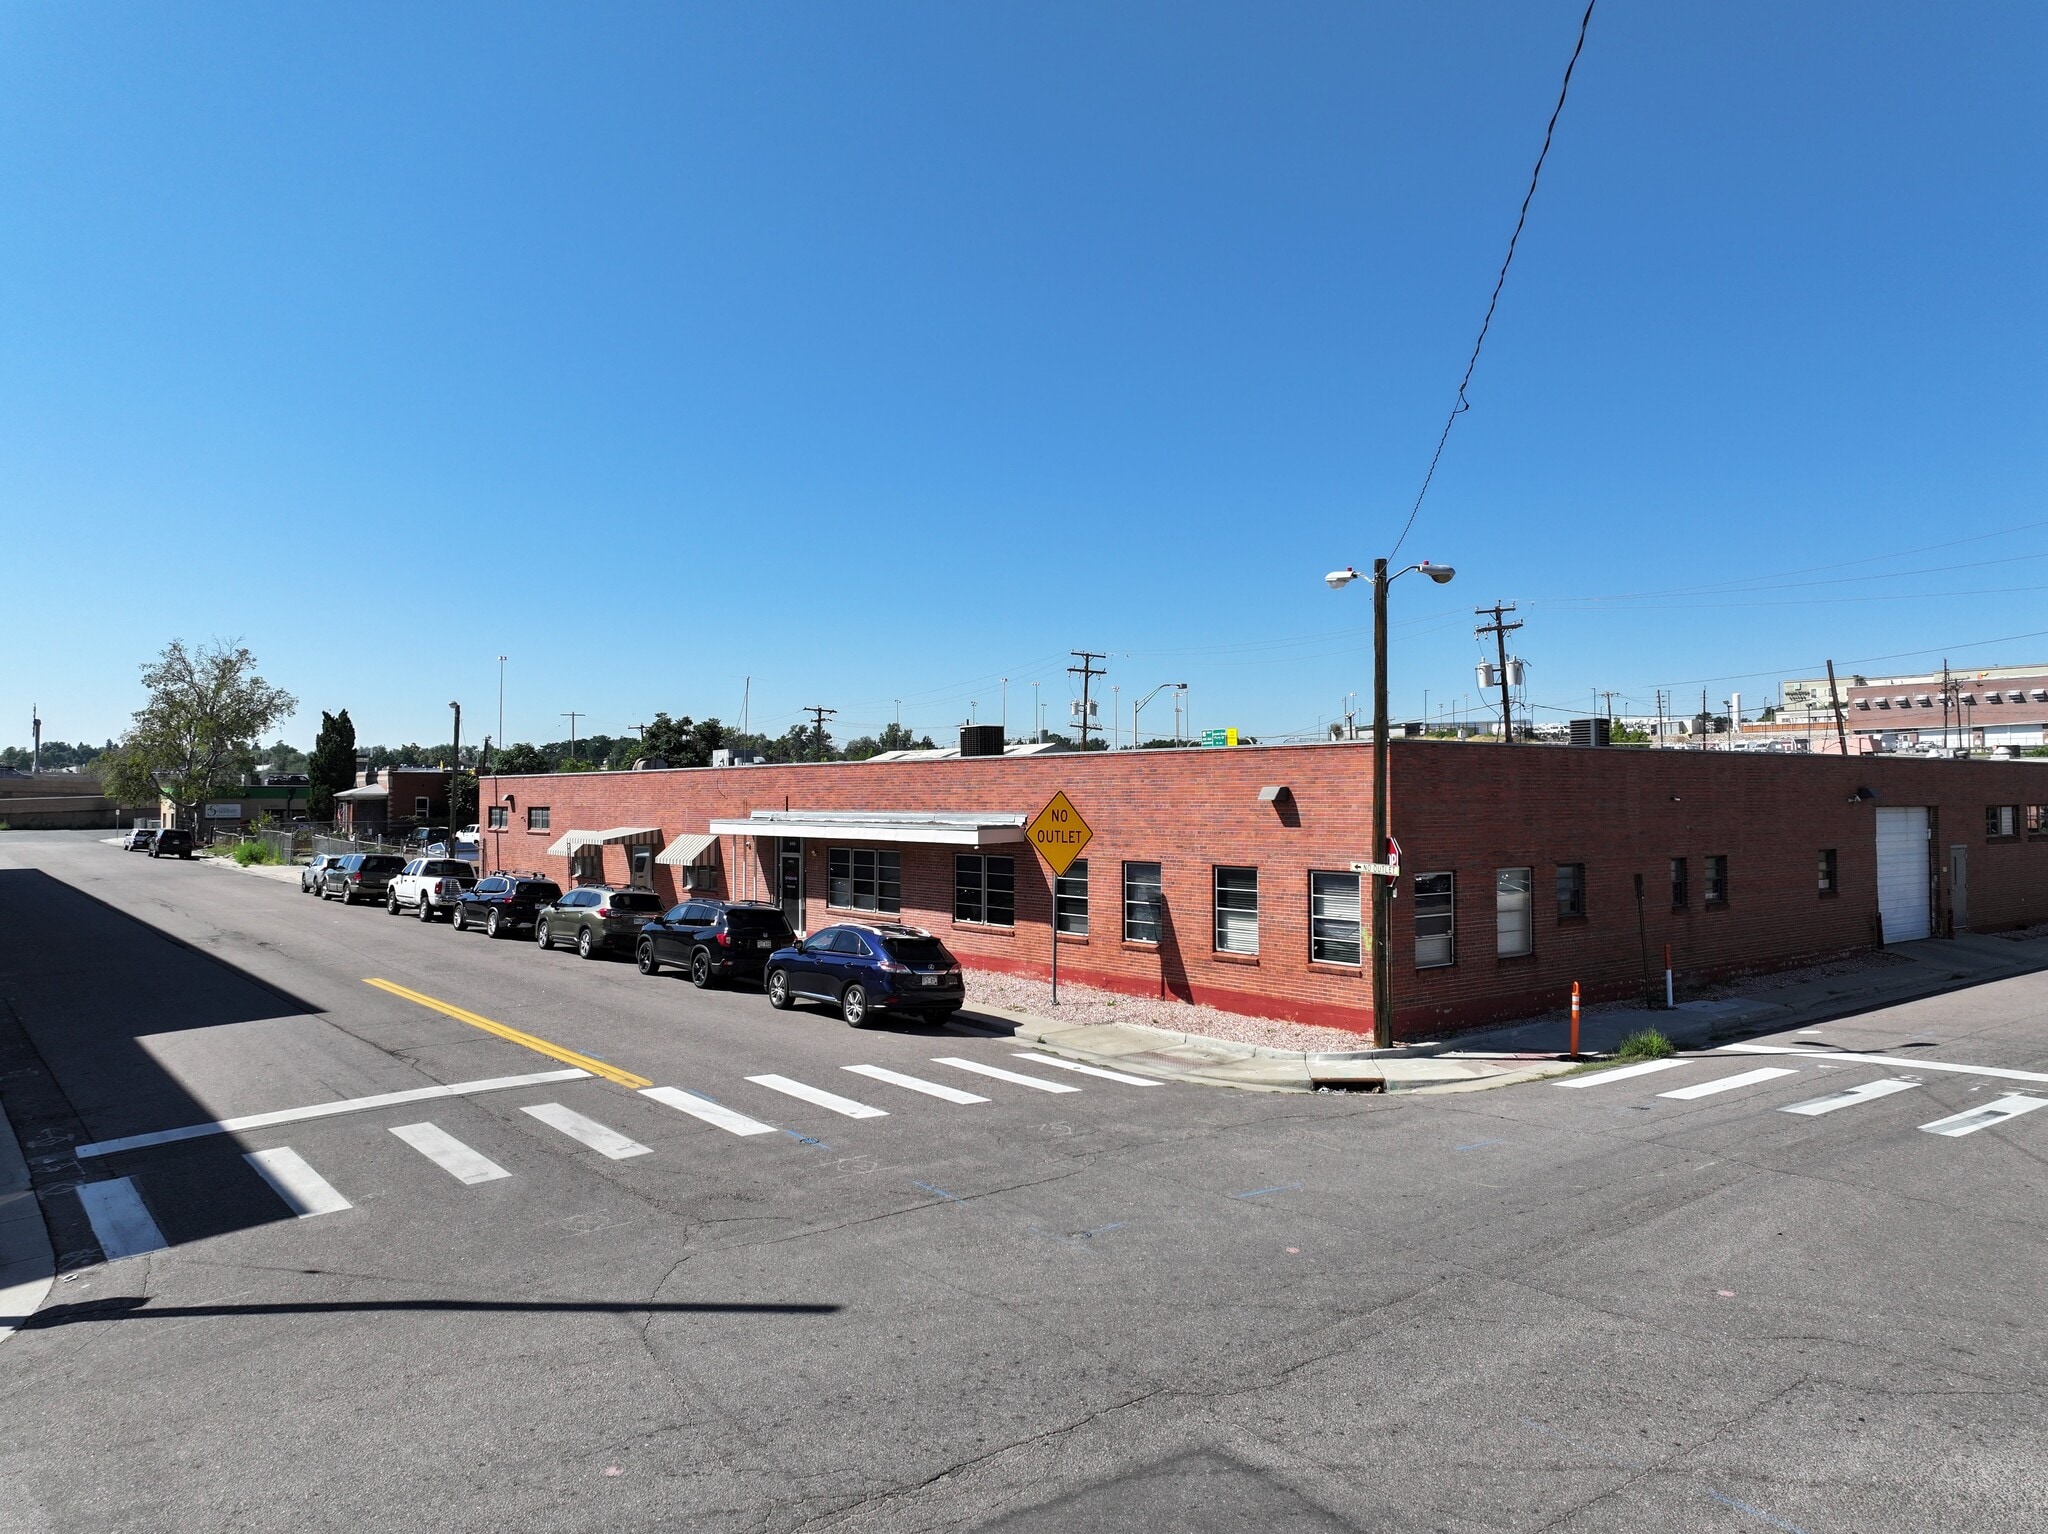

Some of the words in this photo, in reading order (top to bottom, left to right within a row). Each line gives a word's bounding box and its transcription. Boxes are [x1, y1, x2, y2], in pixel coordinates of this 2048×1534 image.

[1051, 809, 1068, 822] NO
[1037, 829, 1082, 843] OUTLET
[1363, 864, 1371, 872] NO
[1373, 864, 1396, 874] OUTLET
